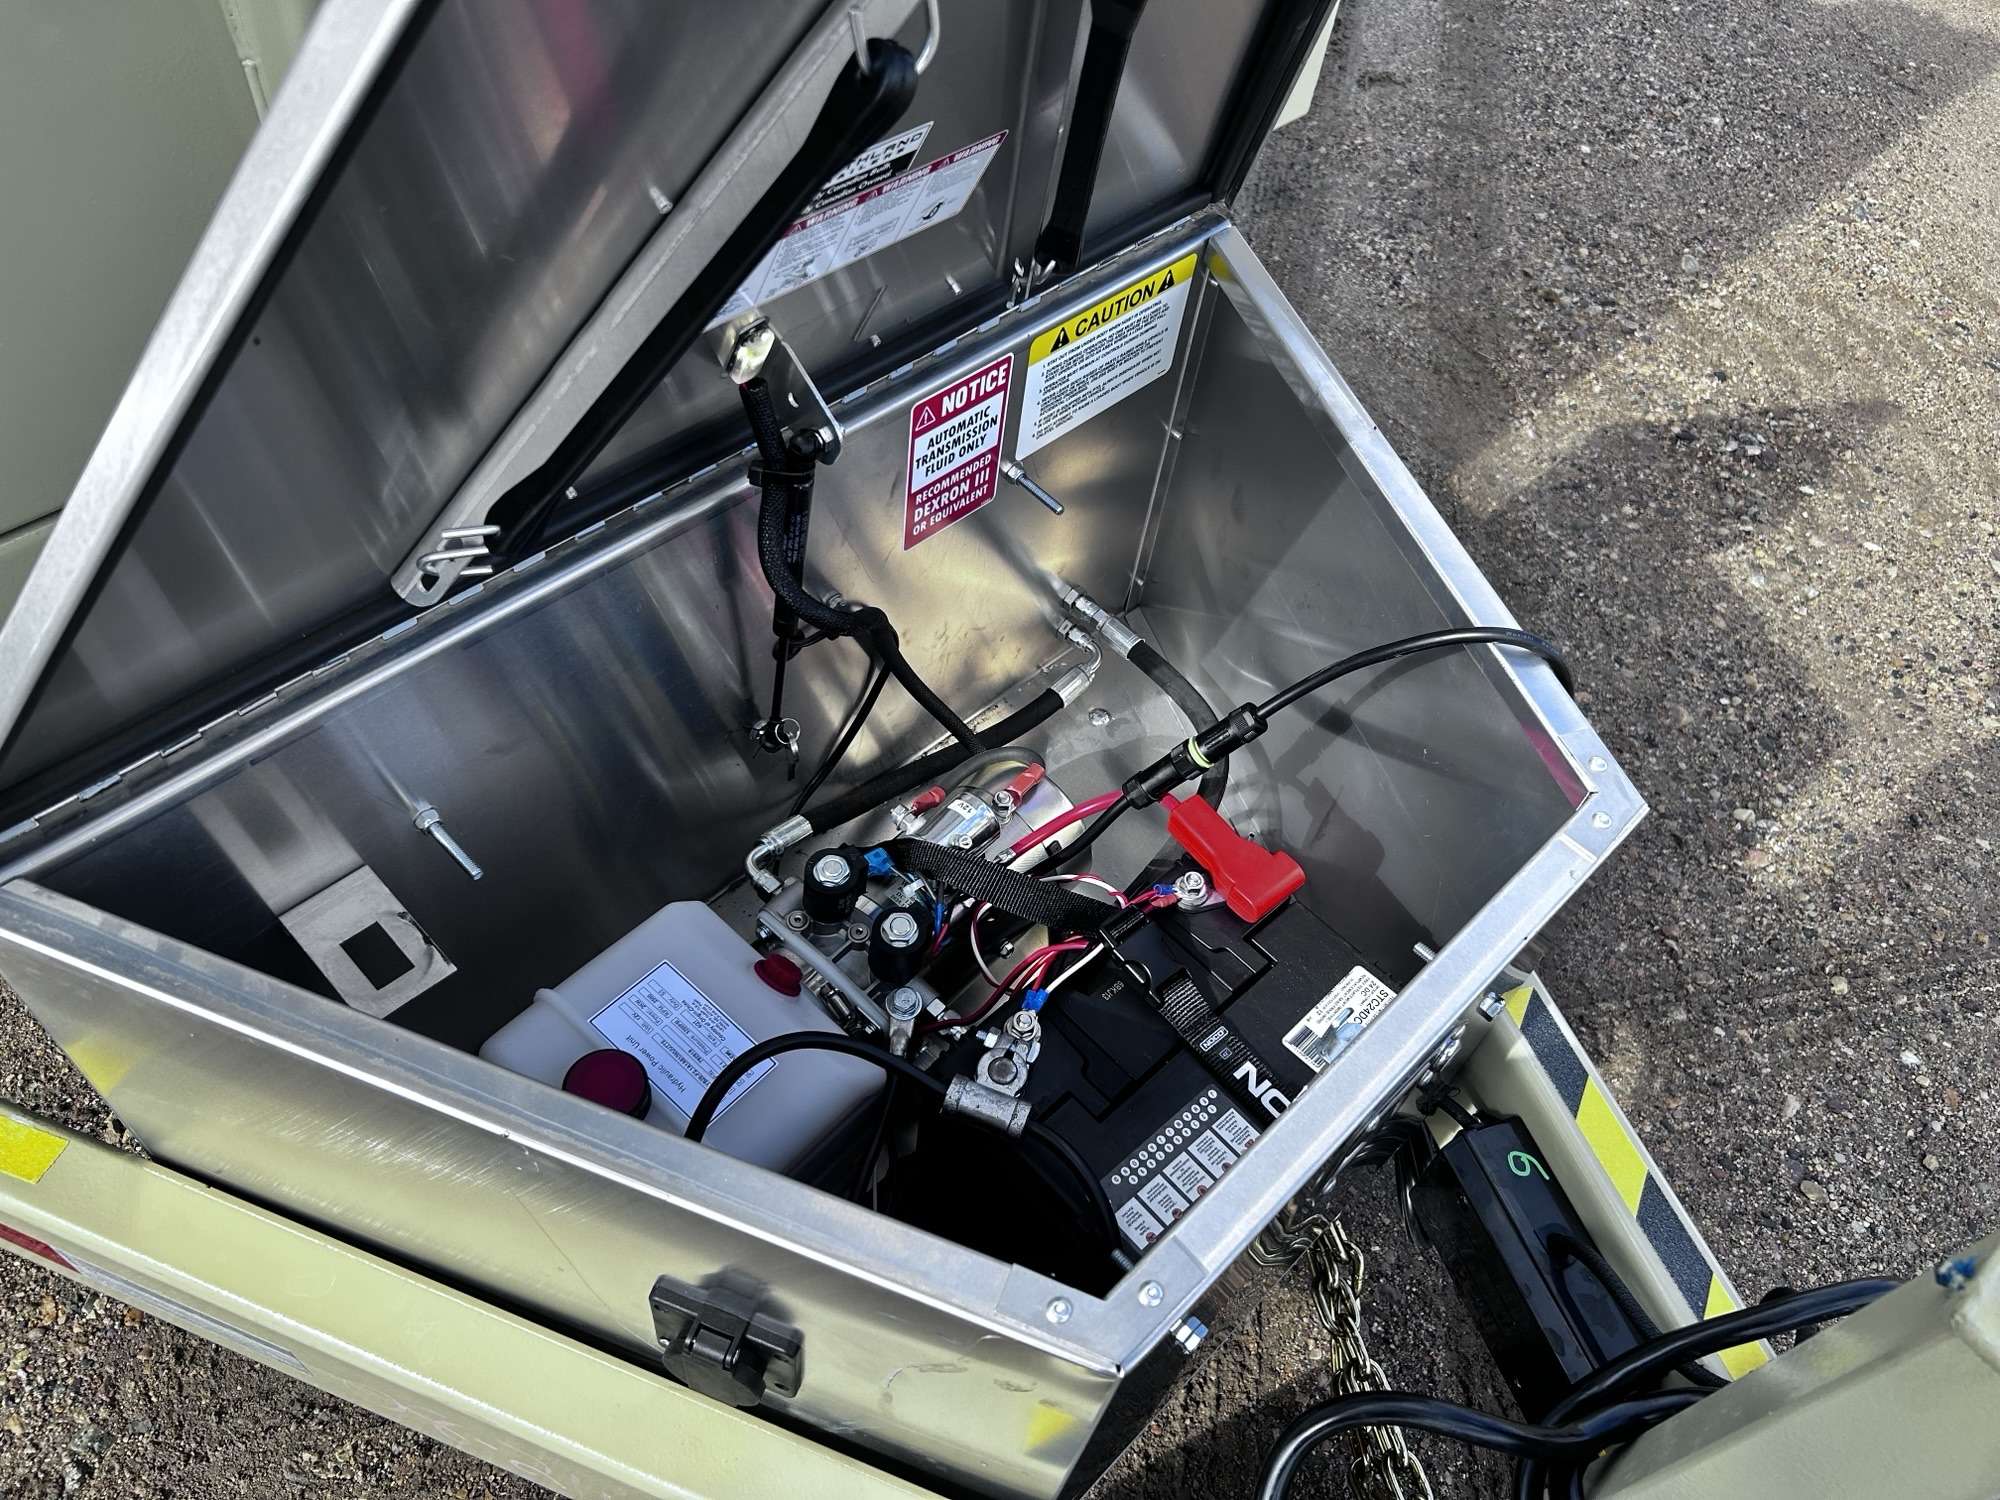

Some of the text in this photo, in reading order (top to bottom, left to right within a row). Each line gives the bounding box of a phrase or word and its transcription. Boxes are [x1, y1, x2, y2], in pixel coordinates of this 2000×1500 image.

[953, 134, 1001, 162] WARNING
[883, 165, 932, 194] WARNING
[806, 197, 859, 227] WARNING
[1075, 281, 1155, 337] CAUTION
[942, 363, 1008, 418] NOTICE
[916, 414, 998, 471] TRANSMISSION
[927, 405, 991, 451] AUTOMATIC
[925, 433, 987, 478] FLUID ONLY
[914, 466, 990, 524] DEXRON III
[916, 452, 992, 507] RECOMMENDED
[913, 483, 988, 537] OR EQUIVALENT
[1360, 987, 1371, 997] DC
[1368, 980, 1377, 989] 24
[1353, 988, 1389, 1026] STC24DC
[625, 1035, 641, 1049] Unit
[1203, 1029, 1225, 1049] NOCO
[637, 1046, 659, 1067] Power
[658, 1064, 687, 1093] Hydraulic
